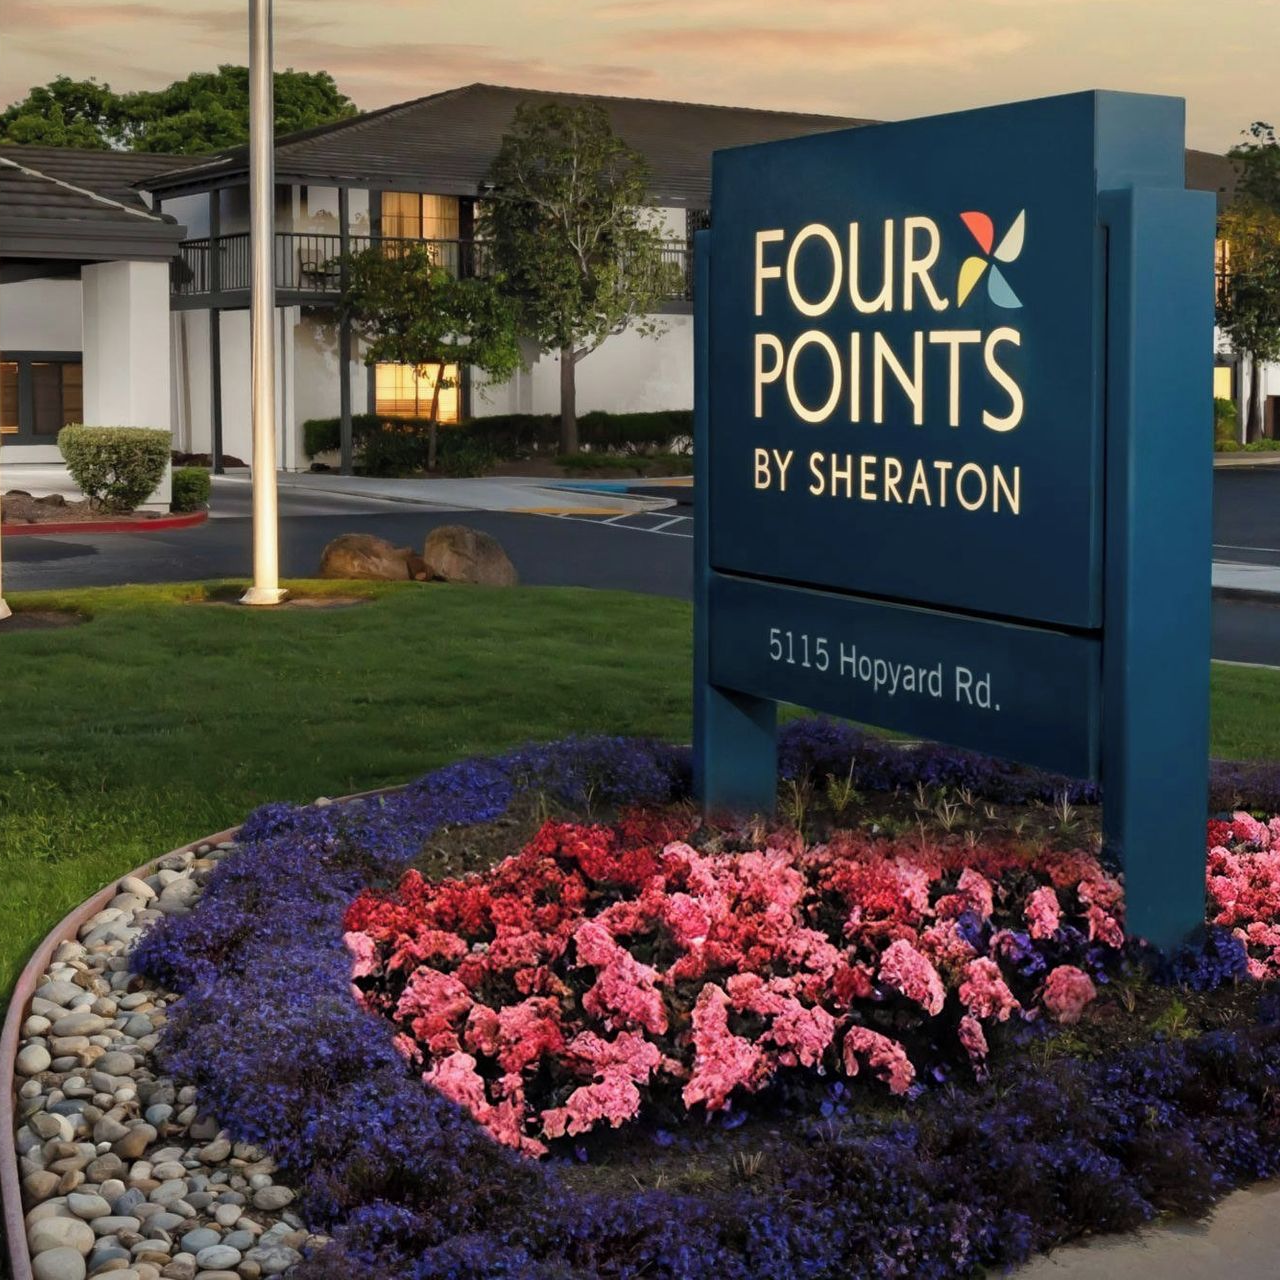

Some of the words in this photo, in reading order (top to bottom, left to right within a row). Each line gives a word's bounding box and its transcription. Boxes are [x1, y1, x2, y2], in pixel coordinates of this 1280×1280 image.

[754, 215, 950, 317] FOUR
[754, 326, 1024, 433] POINTS
[754, 448, 795, 492] BY
[808, 451, 1021, 515] SHERATON
[769, 627, 831, 672] 5115
[839, 641, 943, 699] Hopyard
[954, 665, 1002, 711] Rd.
